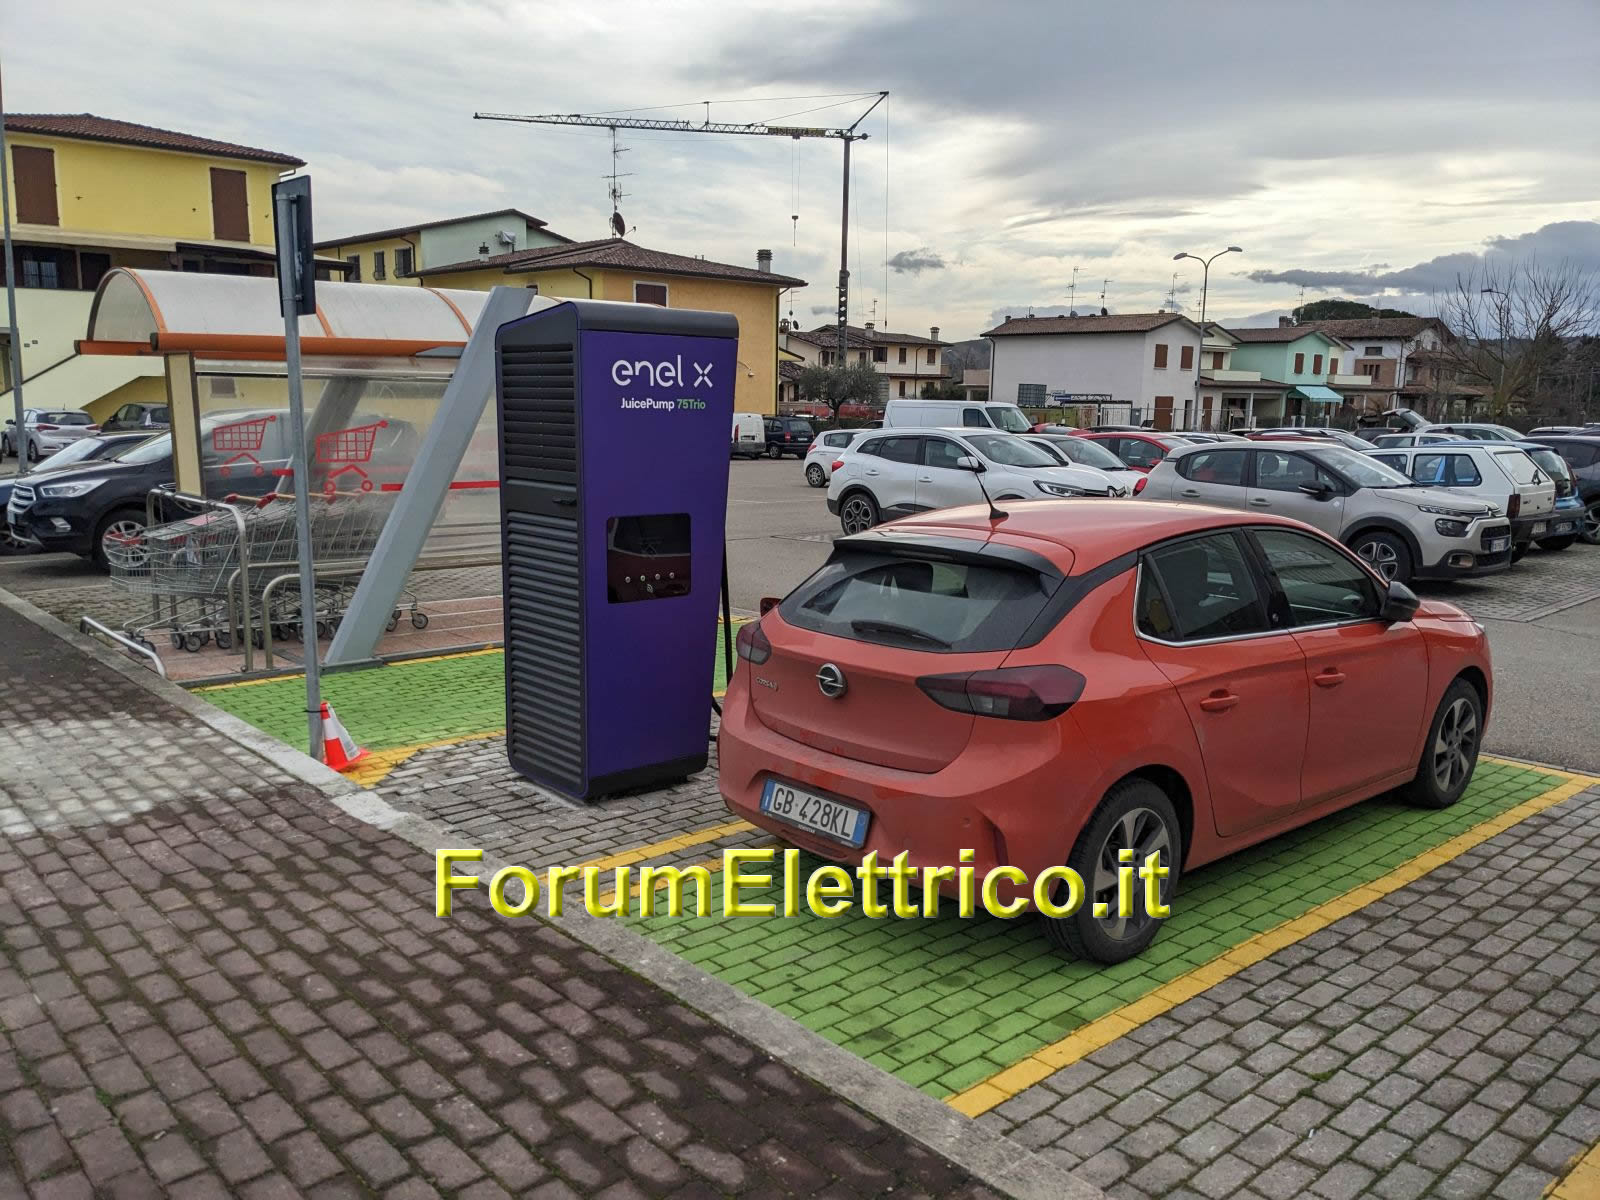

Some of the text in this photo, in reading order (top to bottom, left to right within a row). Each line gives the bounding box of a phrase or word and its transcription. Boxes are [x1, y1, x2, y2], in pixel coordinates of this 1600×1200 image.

[611, 354, 684, 388] enel
[620, 397, 706, 412] JuicePump 75Trio
